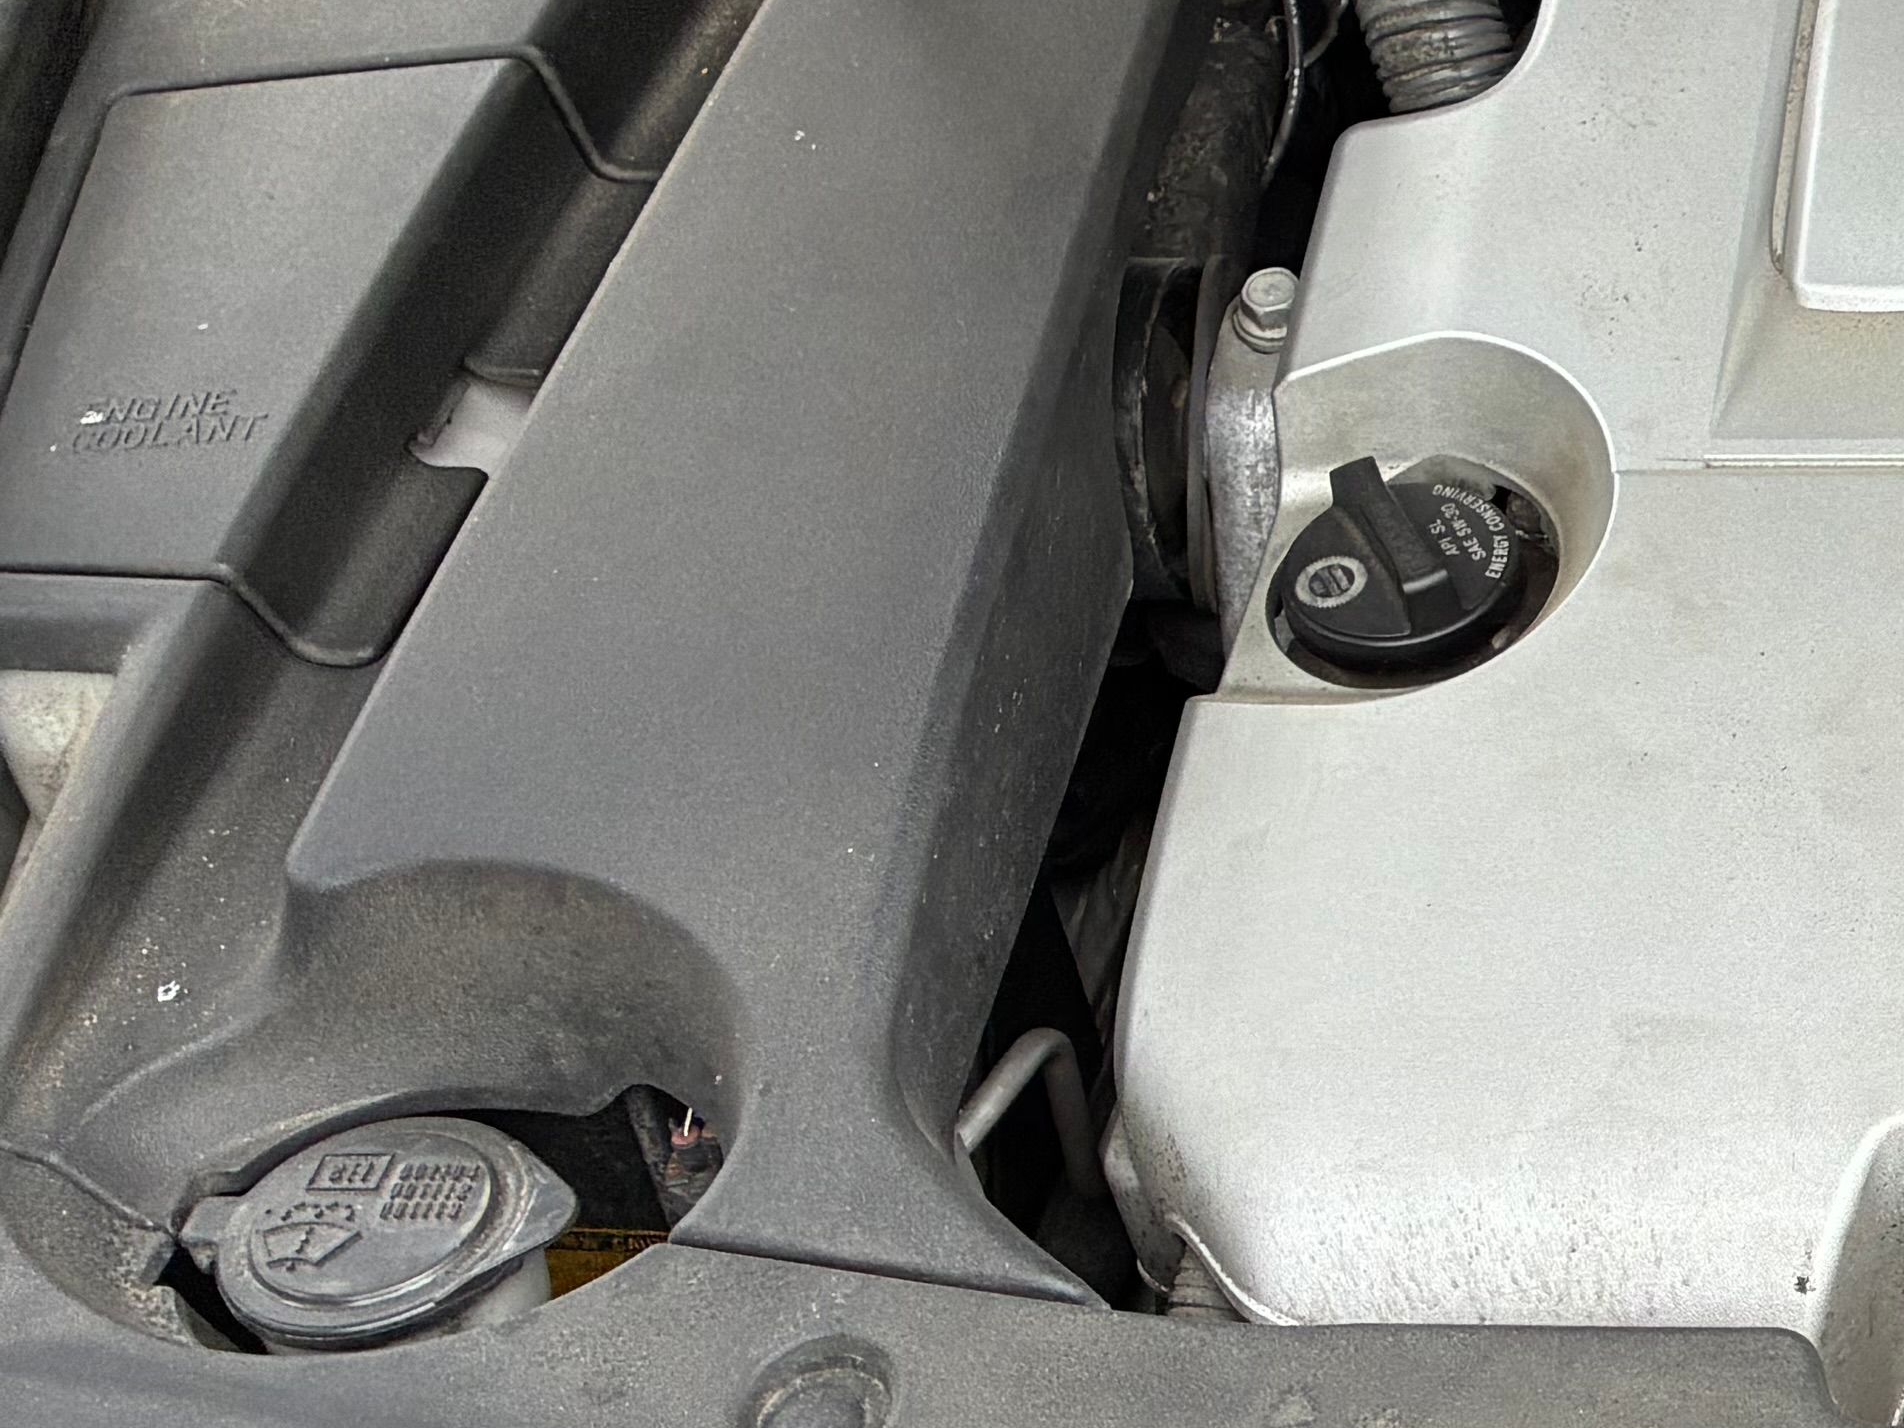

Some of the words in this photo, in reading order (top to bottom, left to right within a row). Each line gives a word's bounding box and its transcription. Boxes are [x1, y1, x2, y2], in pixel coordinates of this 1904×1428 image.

[71, 411, 270, 455] COOLANT
[1431, 483, 1505, 533] CONSERVING
[1437, 536, 1461, 557] API
[1462, 536, 1487, 561] SAE
[1484, 534, 1510, 580] ENERGY
